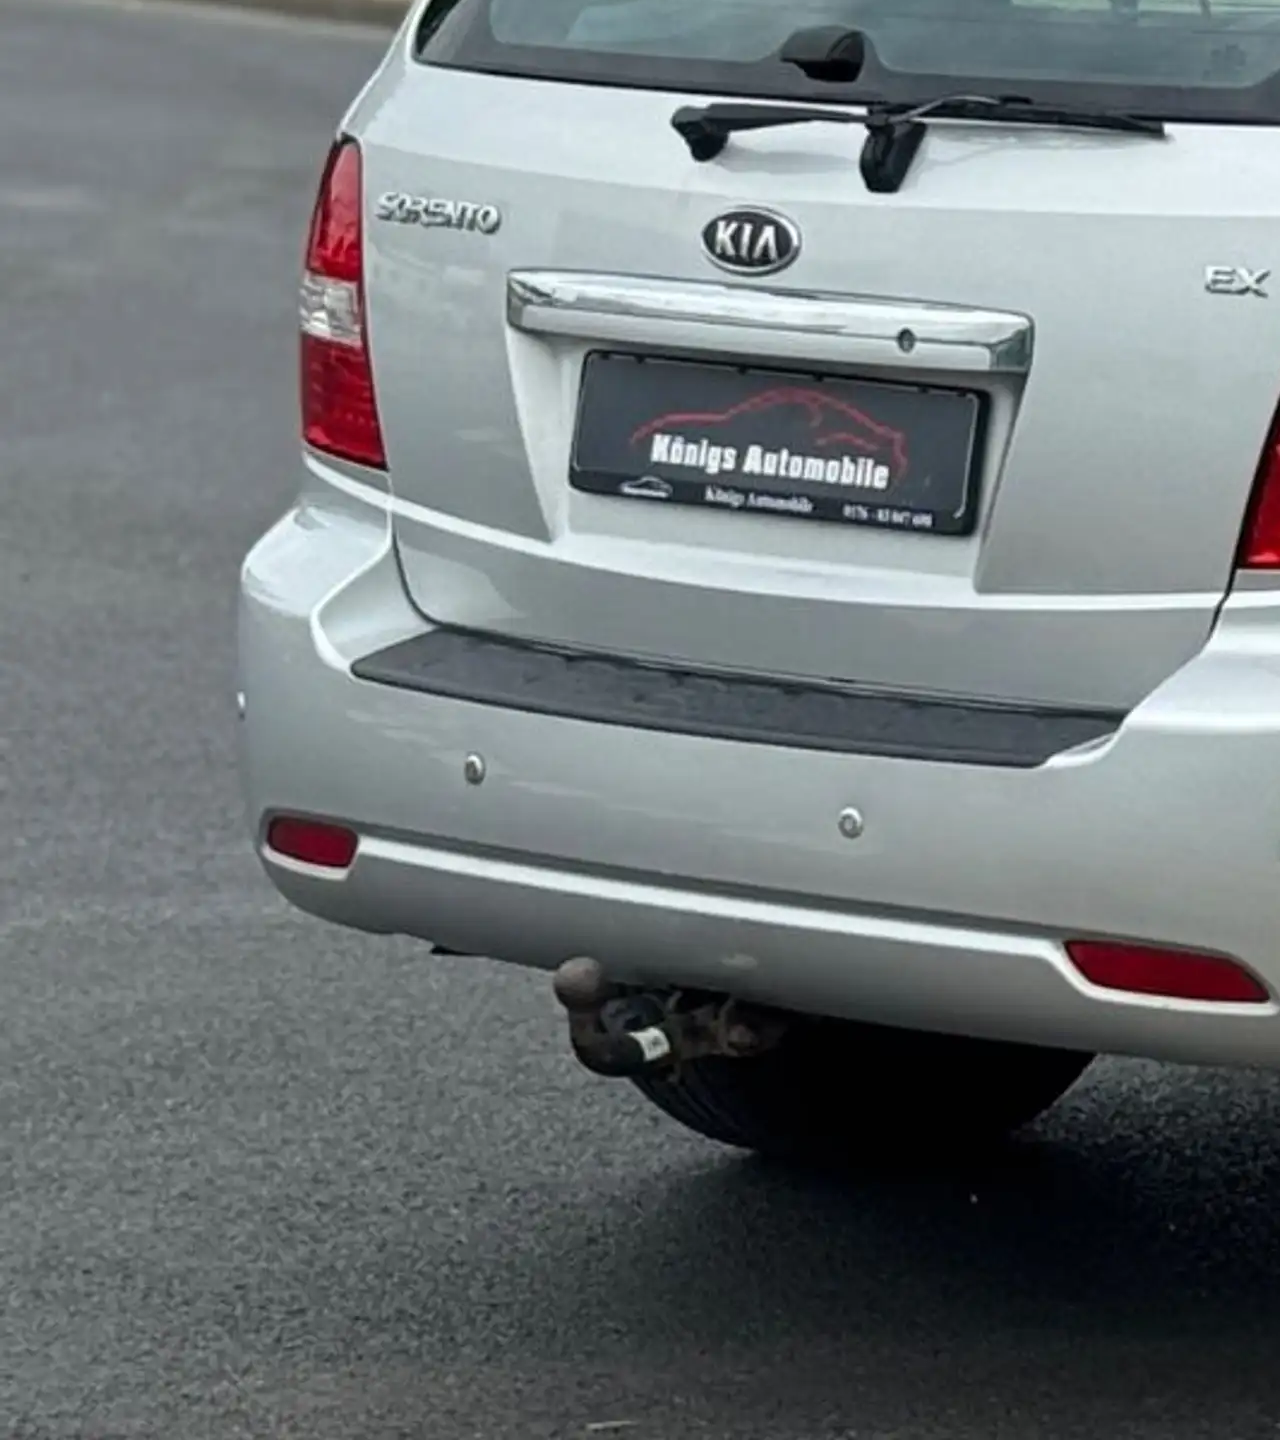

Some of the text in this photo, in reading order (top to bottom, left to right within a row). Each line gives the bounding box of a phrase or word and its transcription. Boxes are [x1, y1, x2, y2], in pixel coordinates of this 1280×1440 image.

[376, 191, 501, 235] SORENTO
[715, 220, 779, 262] KIA
[1205, 265, 1271, 299] EX
[651, 433, 890, 489] Königs Automobile
